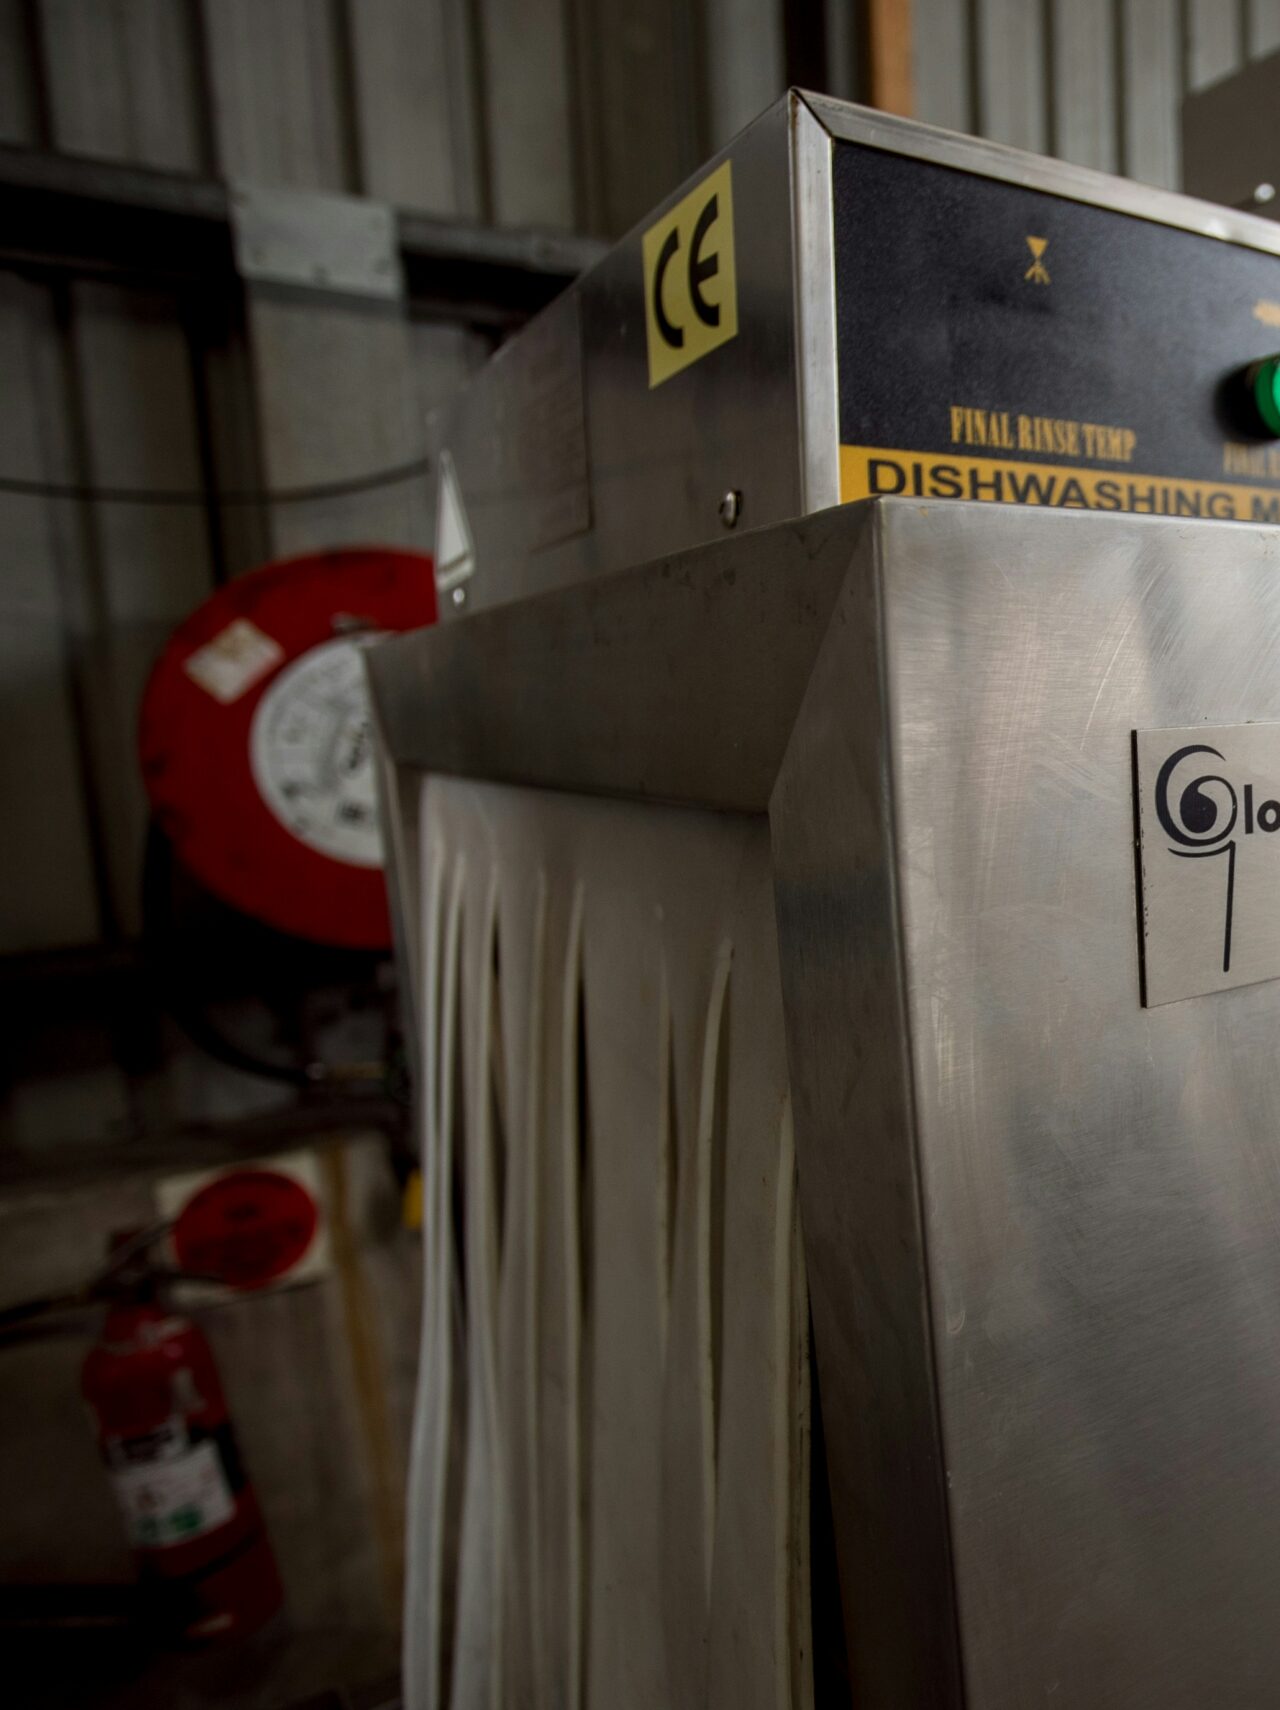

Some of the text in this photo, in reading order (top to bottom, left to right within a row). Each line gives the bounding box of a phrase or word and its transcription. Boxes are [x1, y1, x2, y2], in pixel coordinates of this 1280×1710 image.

[652, 193, 721, 349] CE
[950, 405, 1137, 463] FINAL RINSE TEMP
[867, 458, 1236, 521] DISHWASHING
